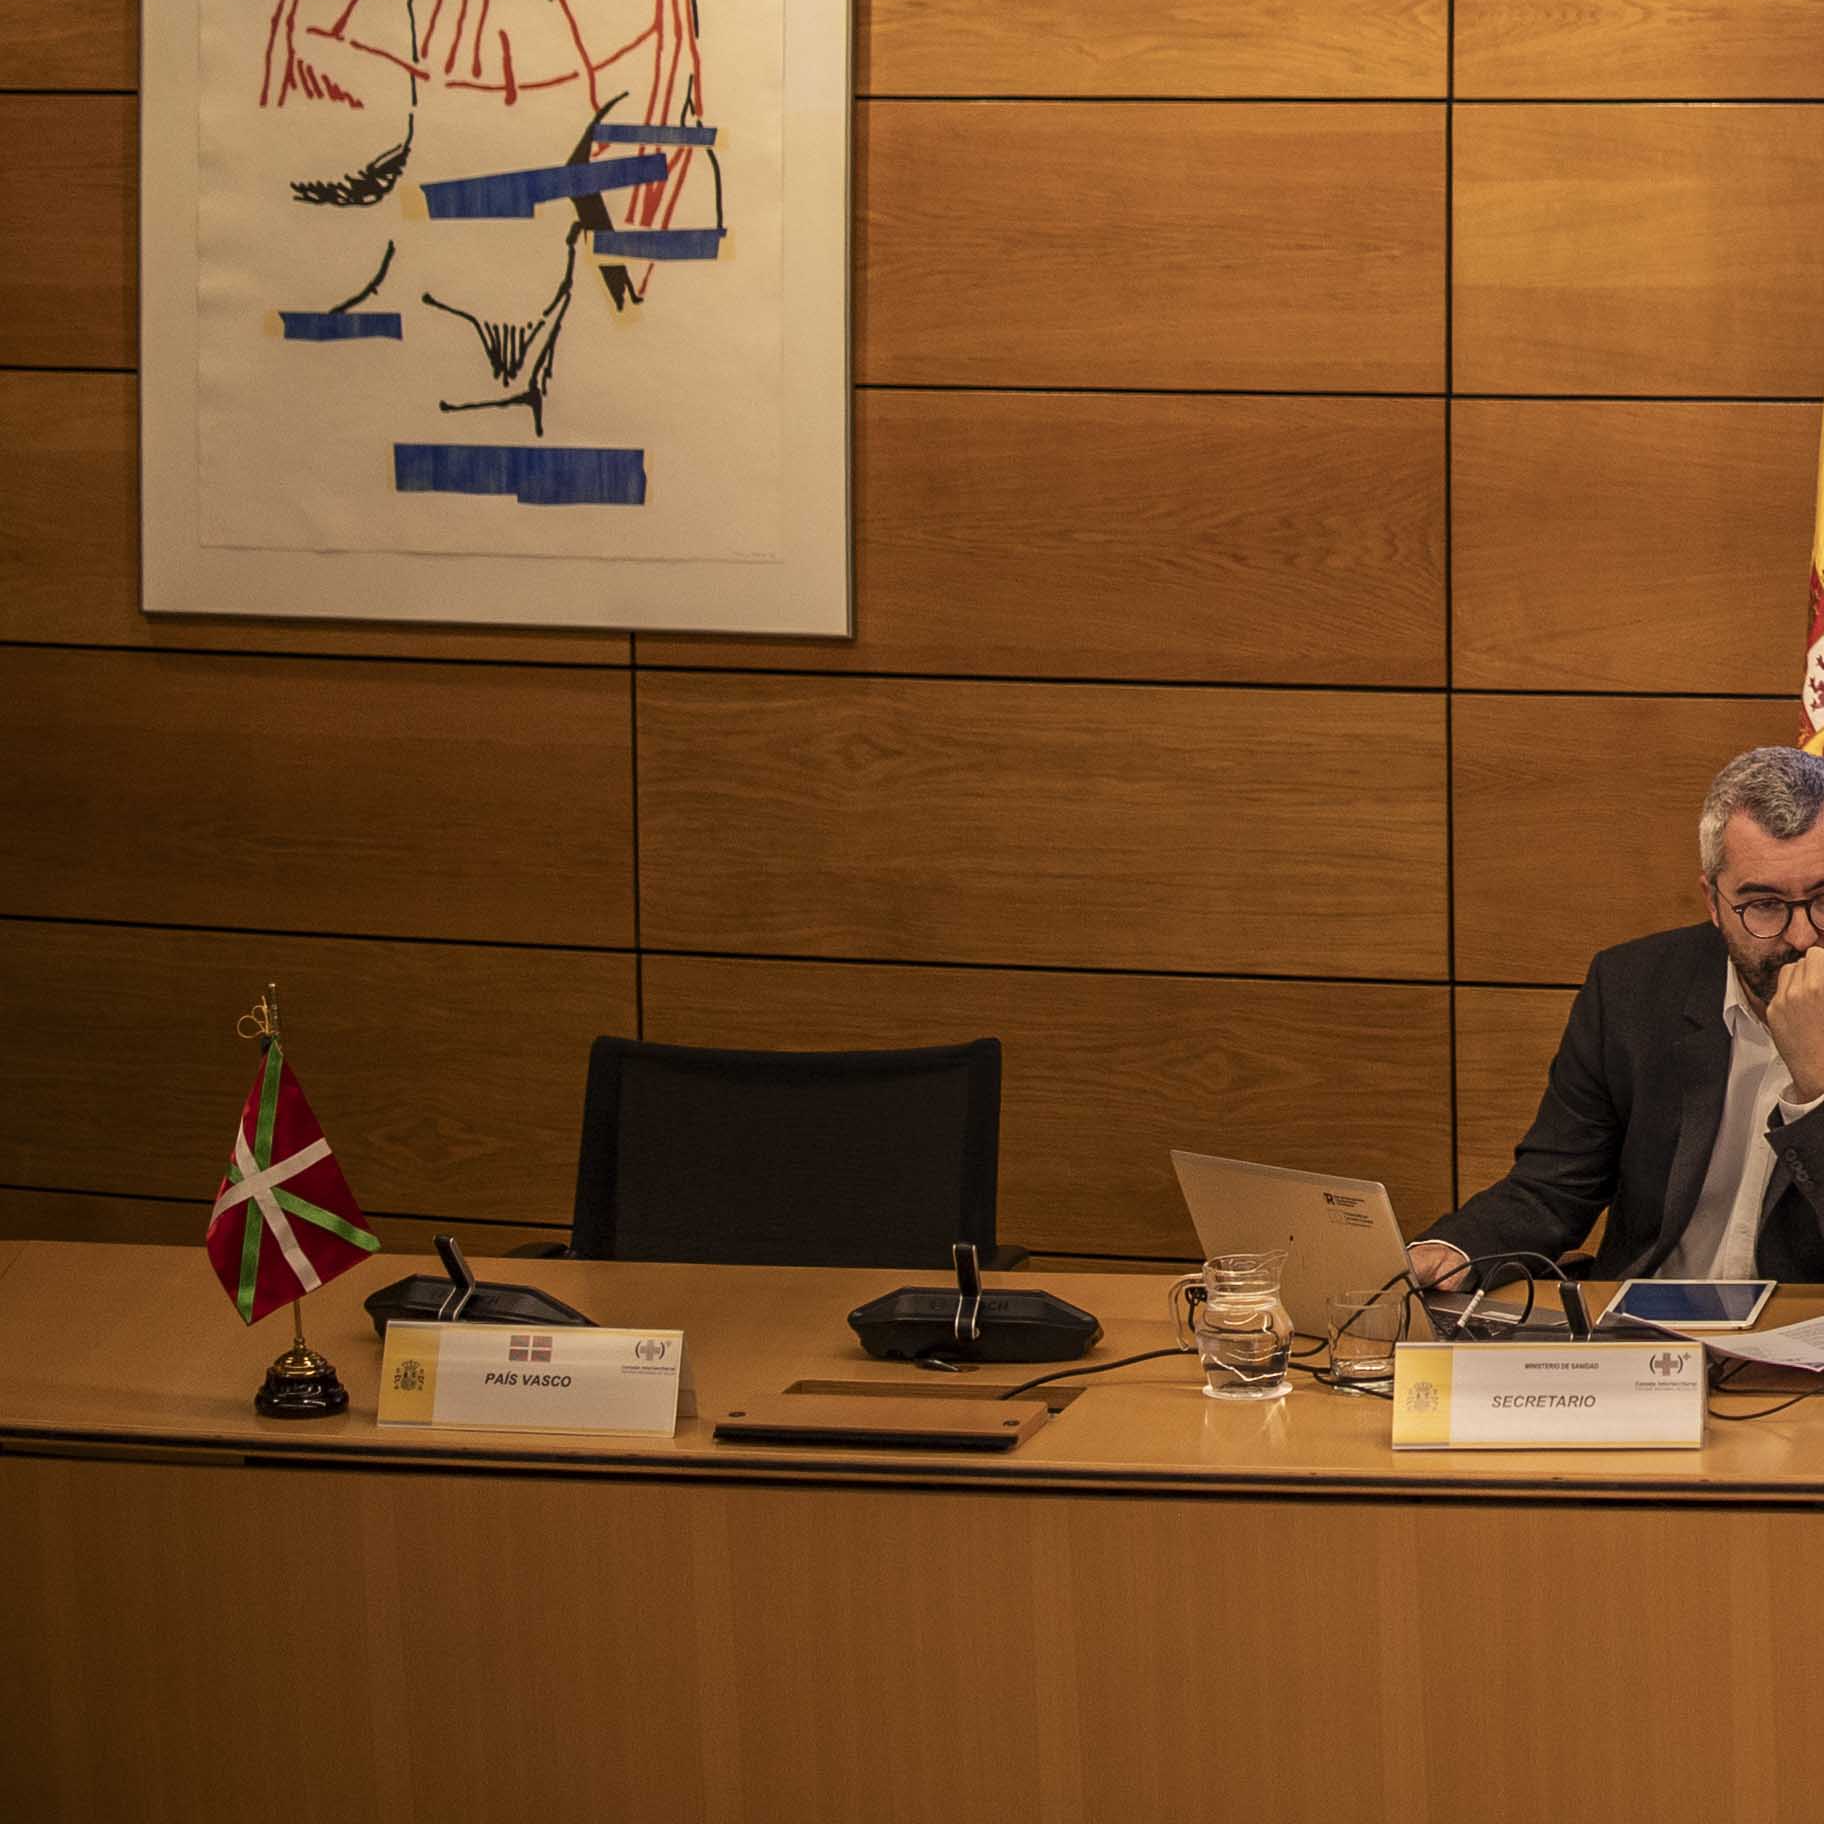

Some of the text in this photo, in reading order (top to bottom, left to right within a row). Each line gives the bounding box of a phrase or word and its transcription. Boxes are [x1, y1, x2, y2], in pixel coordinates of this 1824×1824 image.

[484, 1371, 573, 1388] PAÍS VASCO
[1491, 1394, 1596, 1408] SECRETARIO
